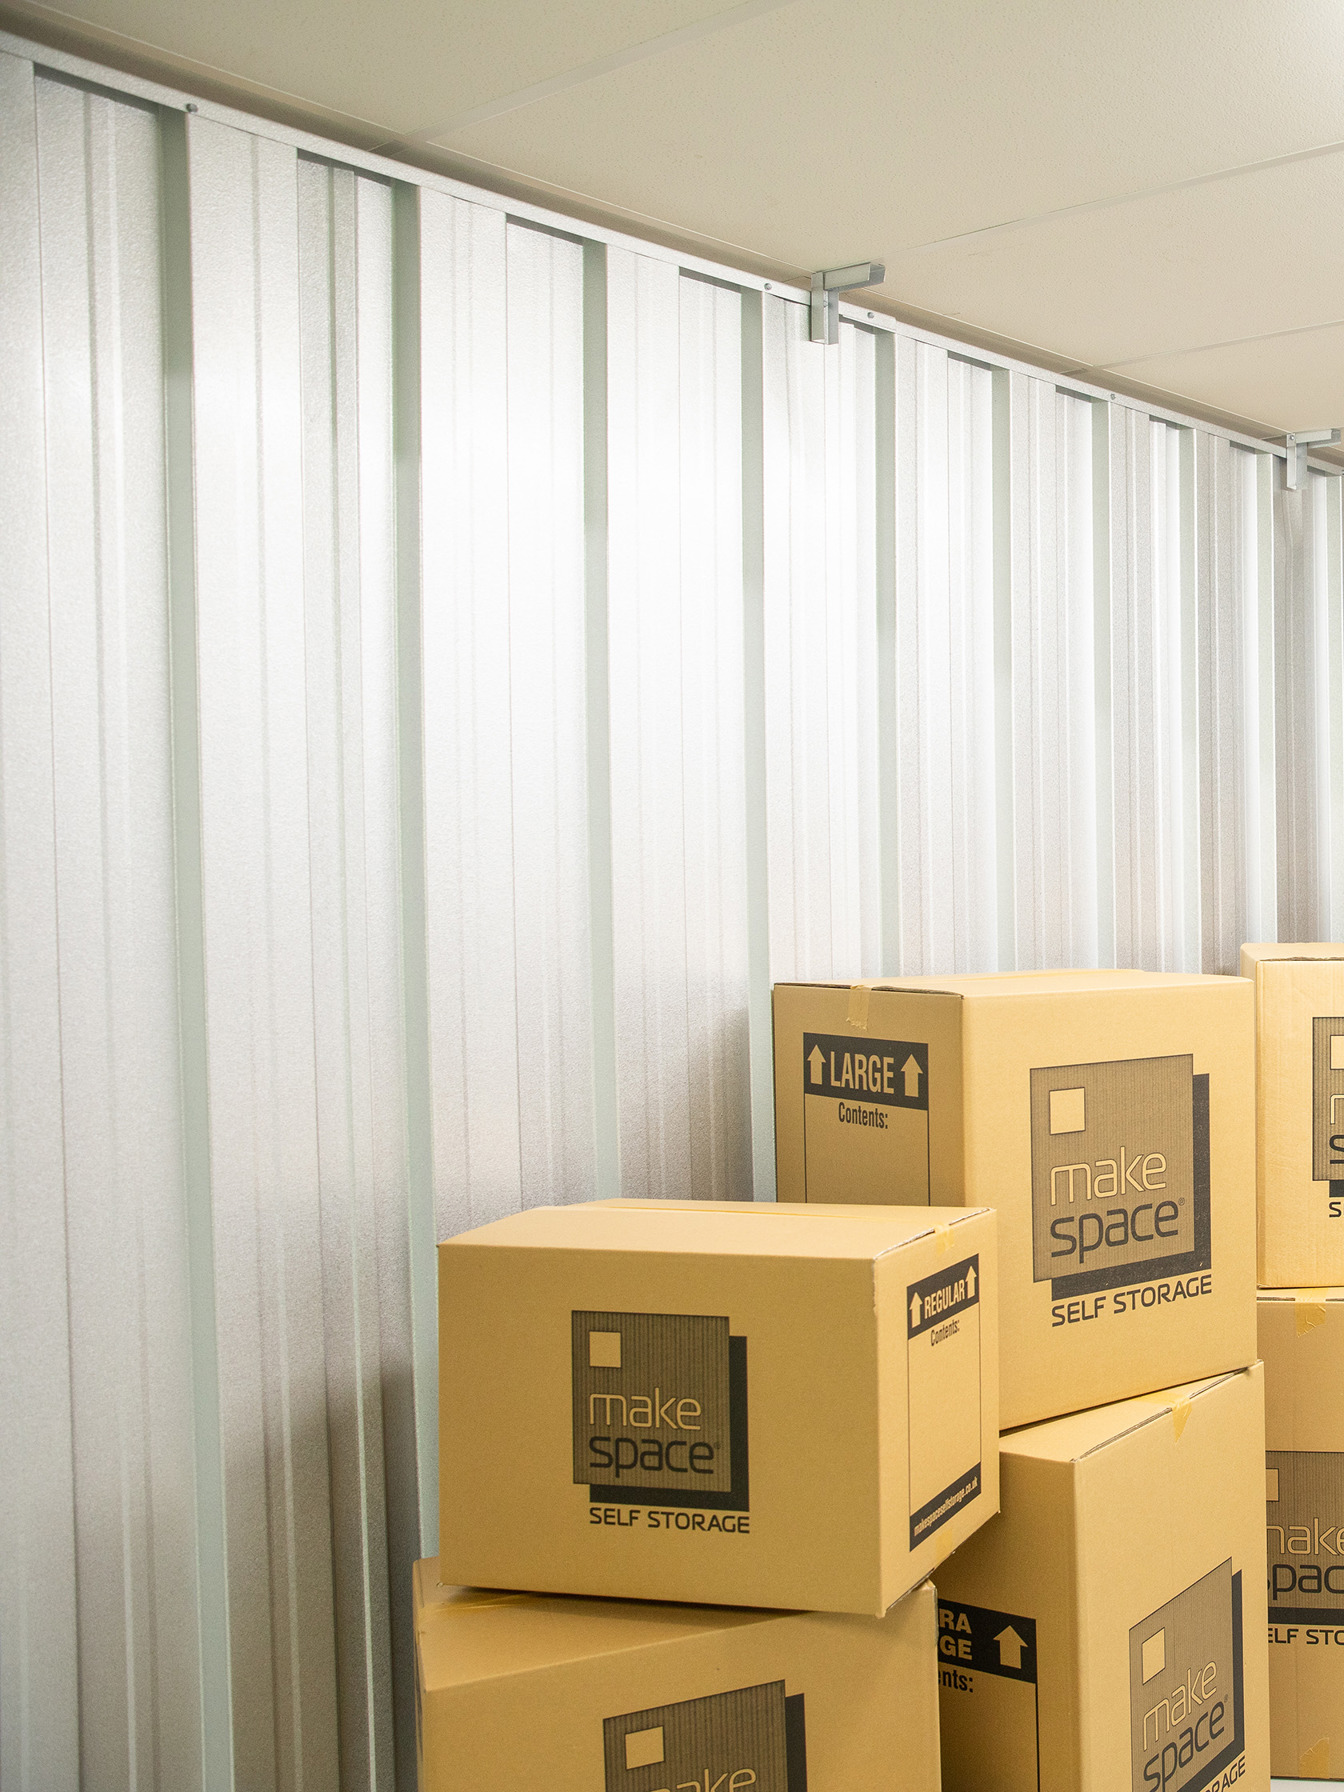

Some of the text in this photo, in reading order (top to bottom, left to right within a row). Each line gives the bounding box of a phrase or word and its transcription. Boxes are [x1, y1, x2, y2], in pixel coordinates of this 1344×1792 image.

[830, 1050, 895, 1094] LARGE
[838, 1102, 888, 1129] Contents:
[1050, 1145, 1167, 1206] make
[1050, 1200, 1179, 1264] space
[924, 1279, 965, 1319] REGULAR
[1052, 1273, 1212, 1328] SELF STORAGE
[930, 1319, 960, 1347] Contents:
[589, 1387, 702, 1430] make
[589, 1436, 714, 1478] space
[589, 1506, 750, 1533] SELF STORAGE
[1143, 1660, 1217, 1751] make
[1143, 1701, 1225, 1792] space
